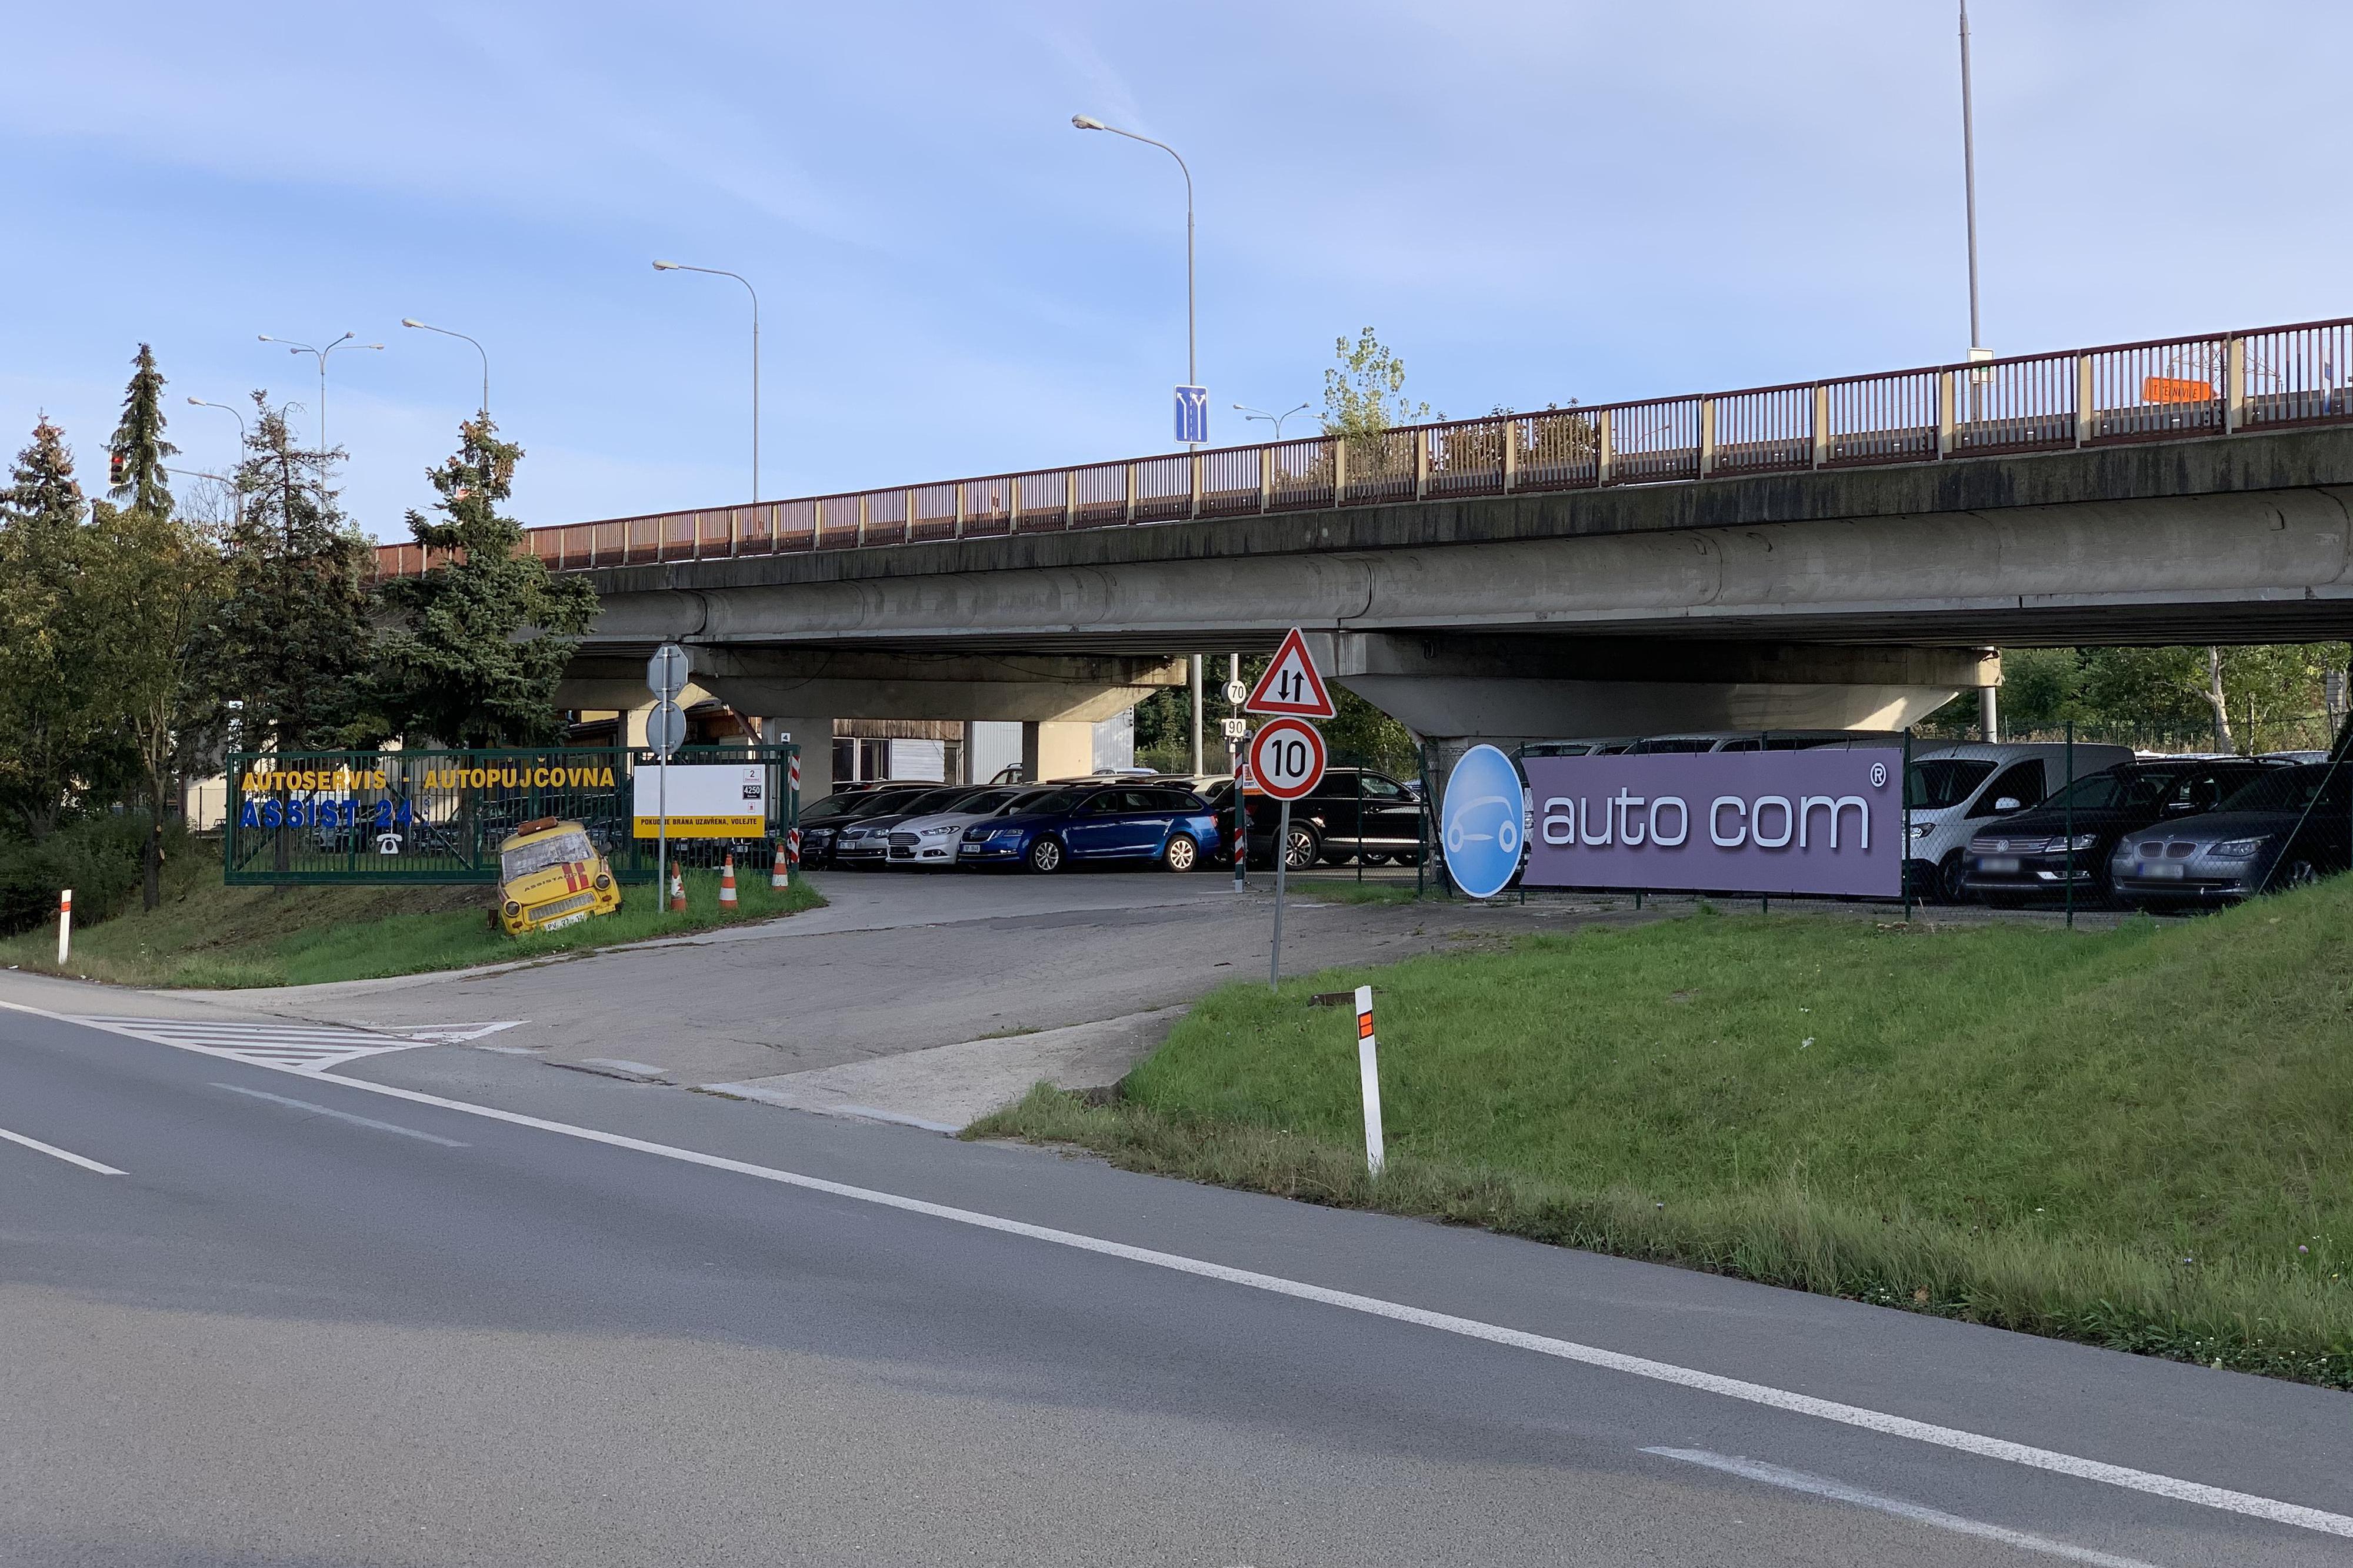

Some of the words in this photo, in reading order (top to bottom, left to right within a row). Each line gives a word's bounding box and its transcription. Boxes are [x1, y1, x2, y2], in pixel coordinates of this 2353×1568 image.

[1232, 686, 1244, 699] 70
[1229, 720, 1242, 733] 90
[1271, 739, 1306, 778] 10
[241, 770, 387, 791] AUTOSERVIS
[239, 798, 360, 829] ASSIST
[375, 798, 412, 828] 24
[672, 816, 694, 825] BRÁNA
[1542, 787, 1688, 846] auto
[1709, 795, 1869, 849] com
